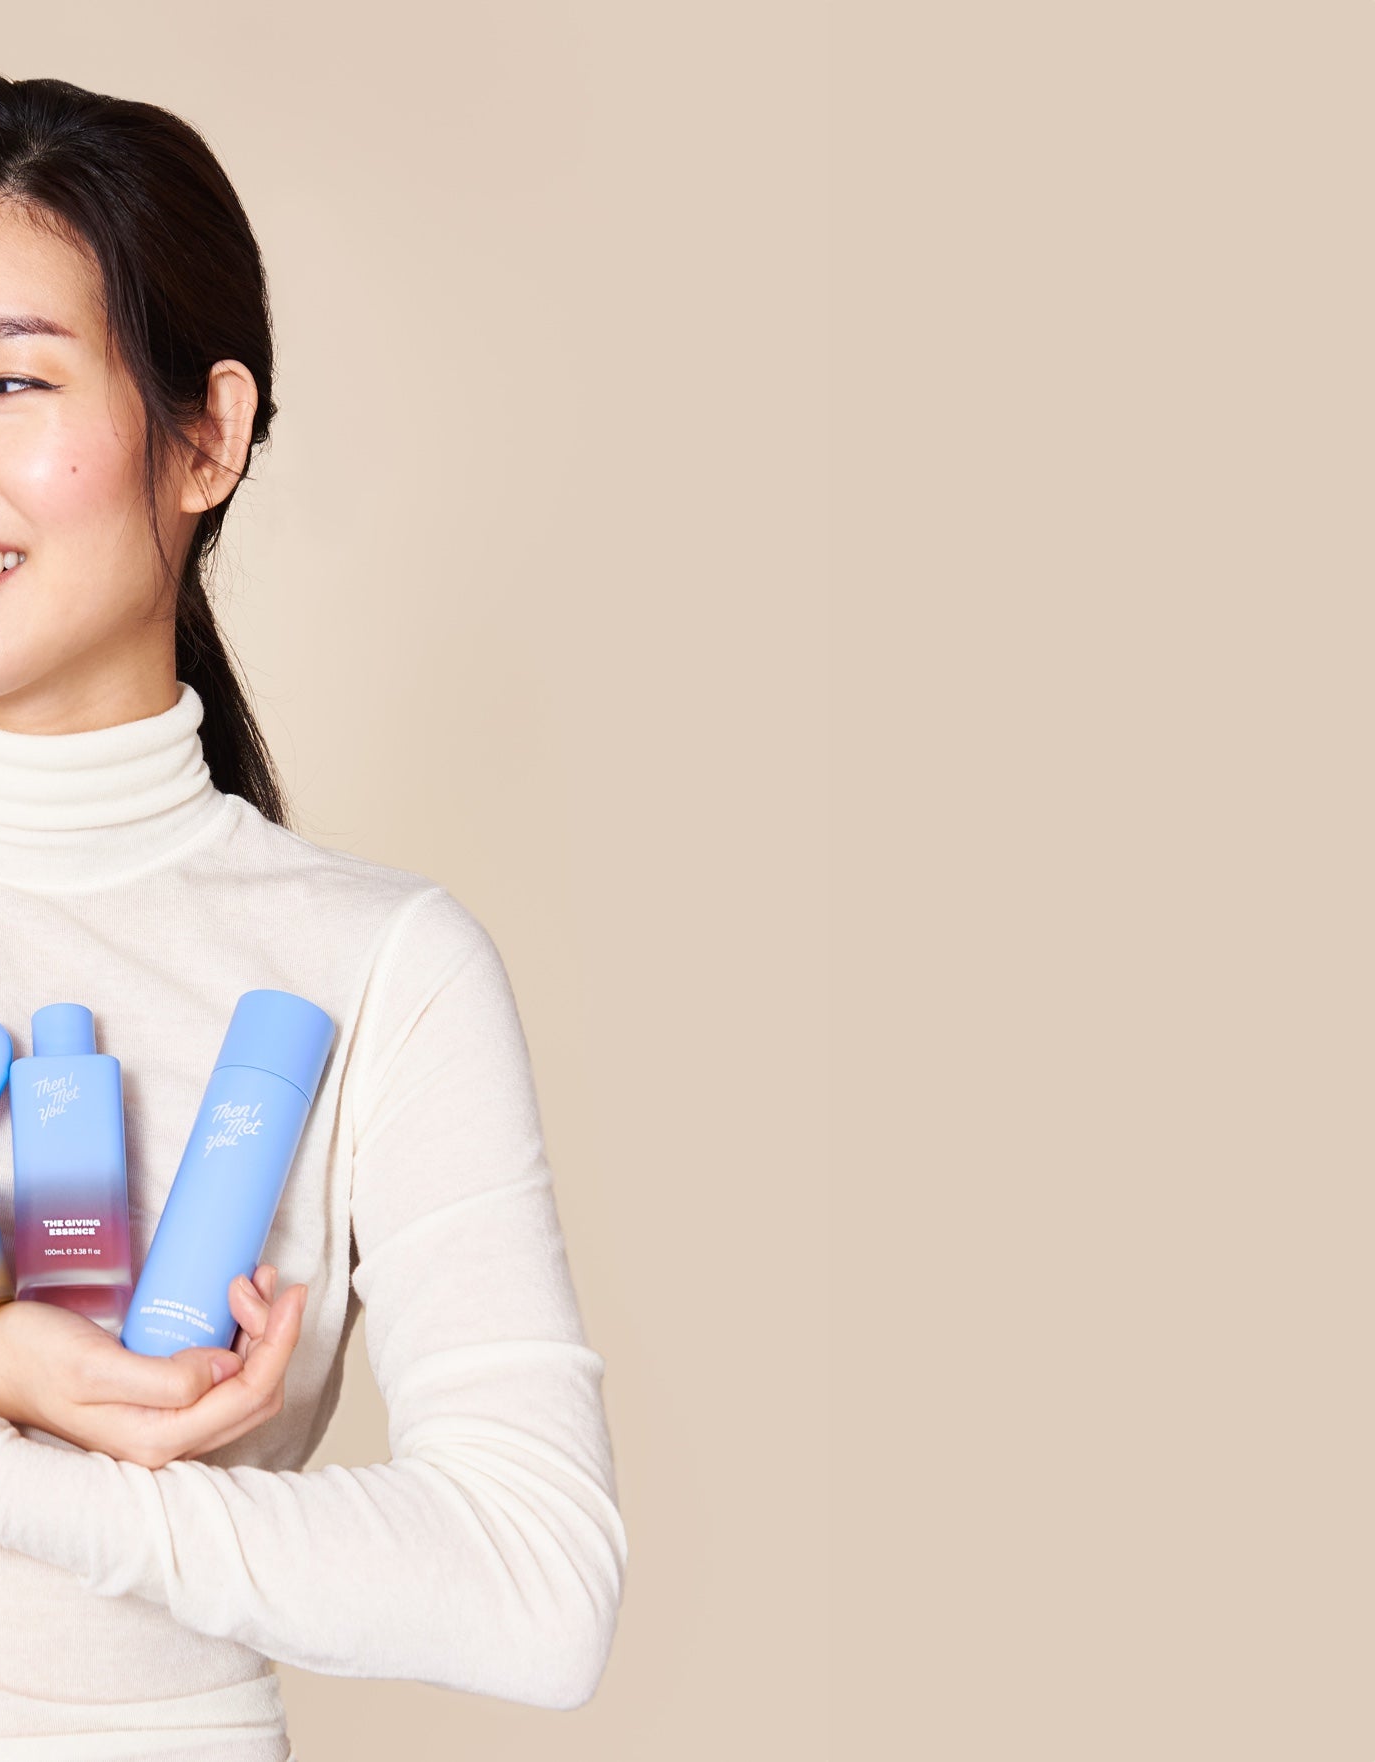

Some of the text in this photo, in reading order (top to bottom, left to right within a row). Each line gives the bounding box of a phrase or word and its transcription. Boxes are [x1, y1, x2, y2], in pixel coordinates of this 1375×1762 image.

[32, 1076, 67, 1098] Then
[49, 1085, 81, 1105] Met
[37, 1103, 67, 1129] You
[211, 1100, 250, 1124] Then
[223, 1117, 264, 1136] Met
[204, 1130, 239, 1158] You
[42, 1219, 101, 1228] THE GIVING
[49, 1227, 96, 1236] ESSENCE
[44, 1248, 66, 1256] 100mL
[153, 1299, 208, 1320] BIRCH MILK
[140, 1306, 215, 1336] REFINING TONER
